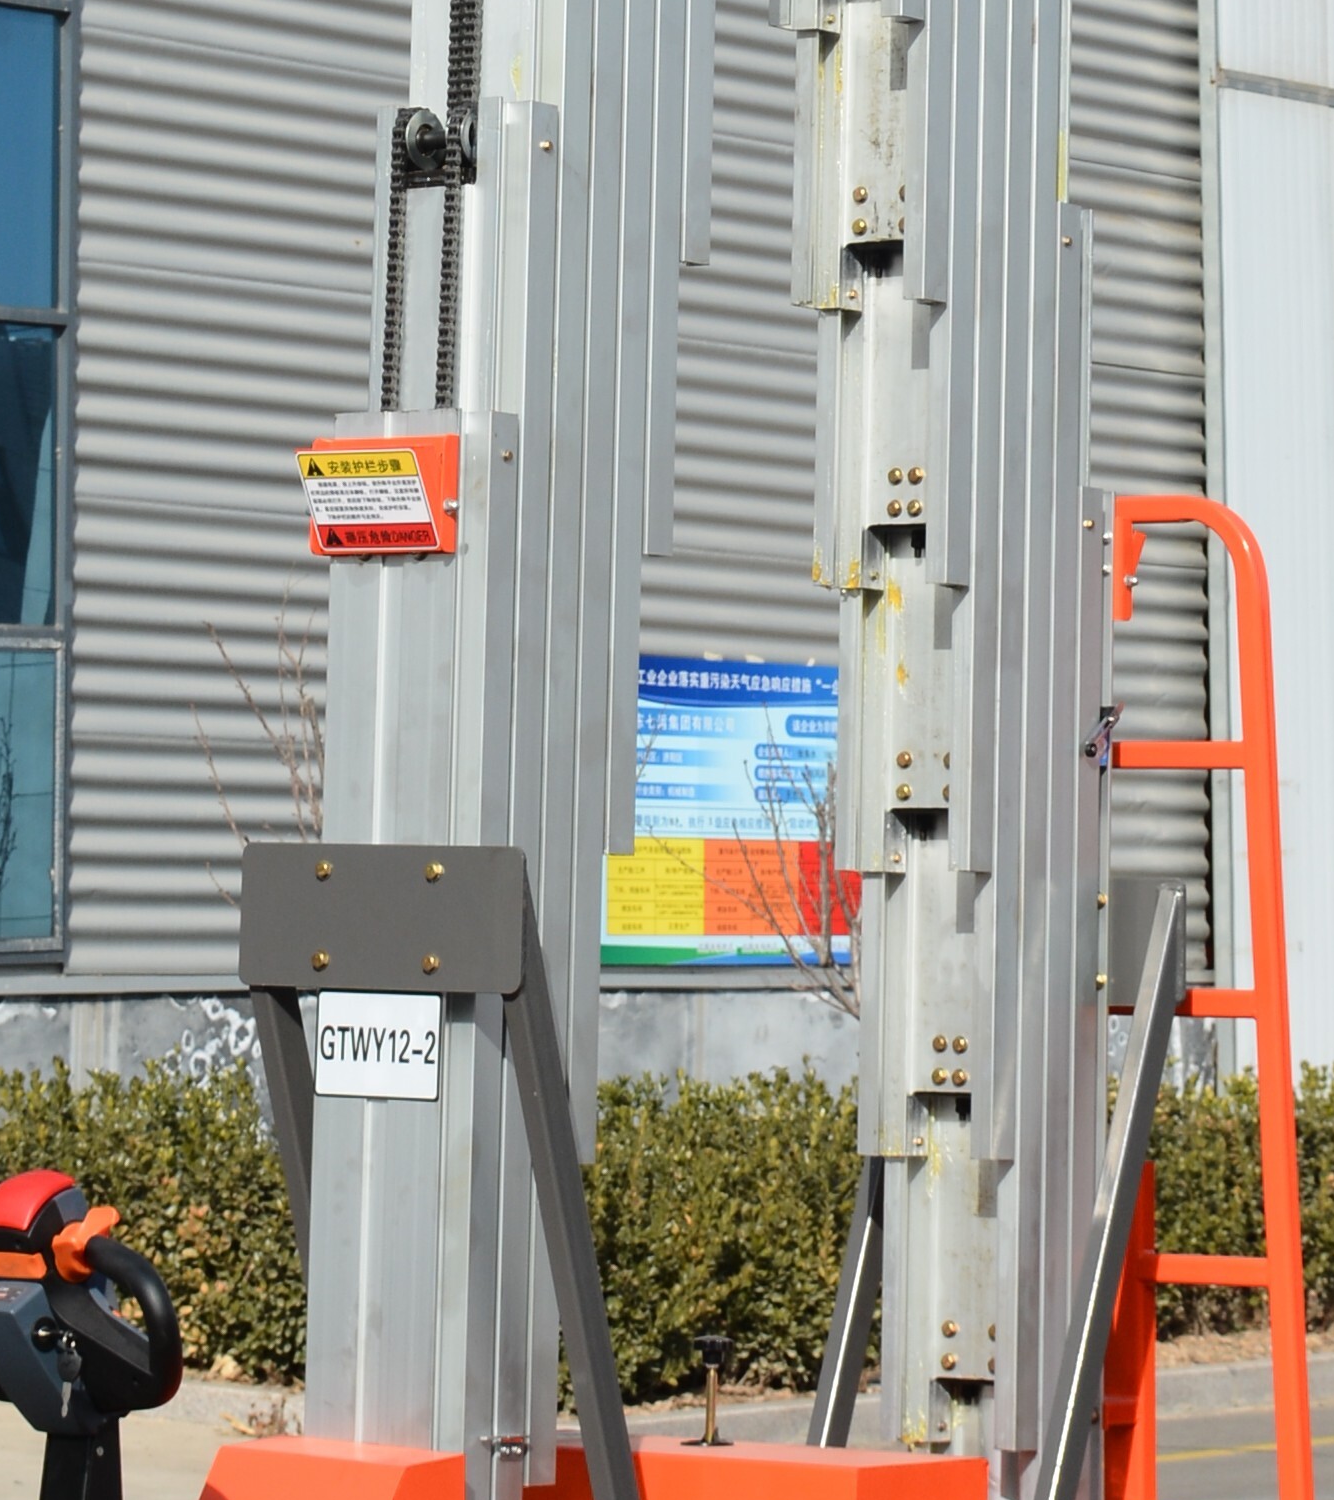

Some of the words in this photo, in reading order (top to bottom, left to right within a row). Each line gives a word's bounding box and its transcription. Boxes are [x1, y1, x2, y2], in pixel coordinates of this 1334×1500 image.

[327, 458, 403, 475] 安装护栏步骤
[320, 1025, 437, 1065] GTWY12-2
